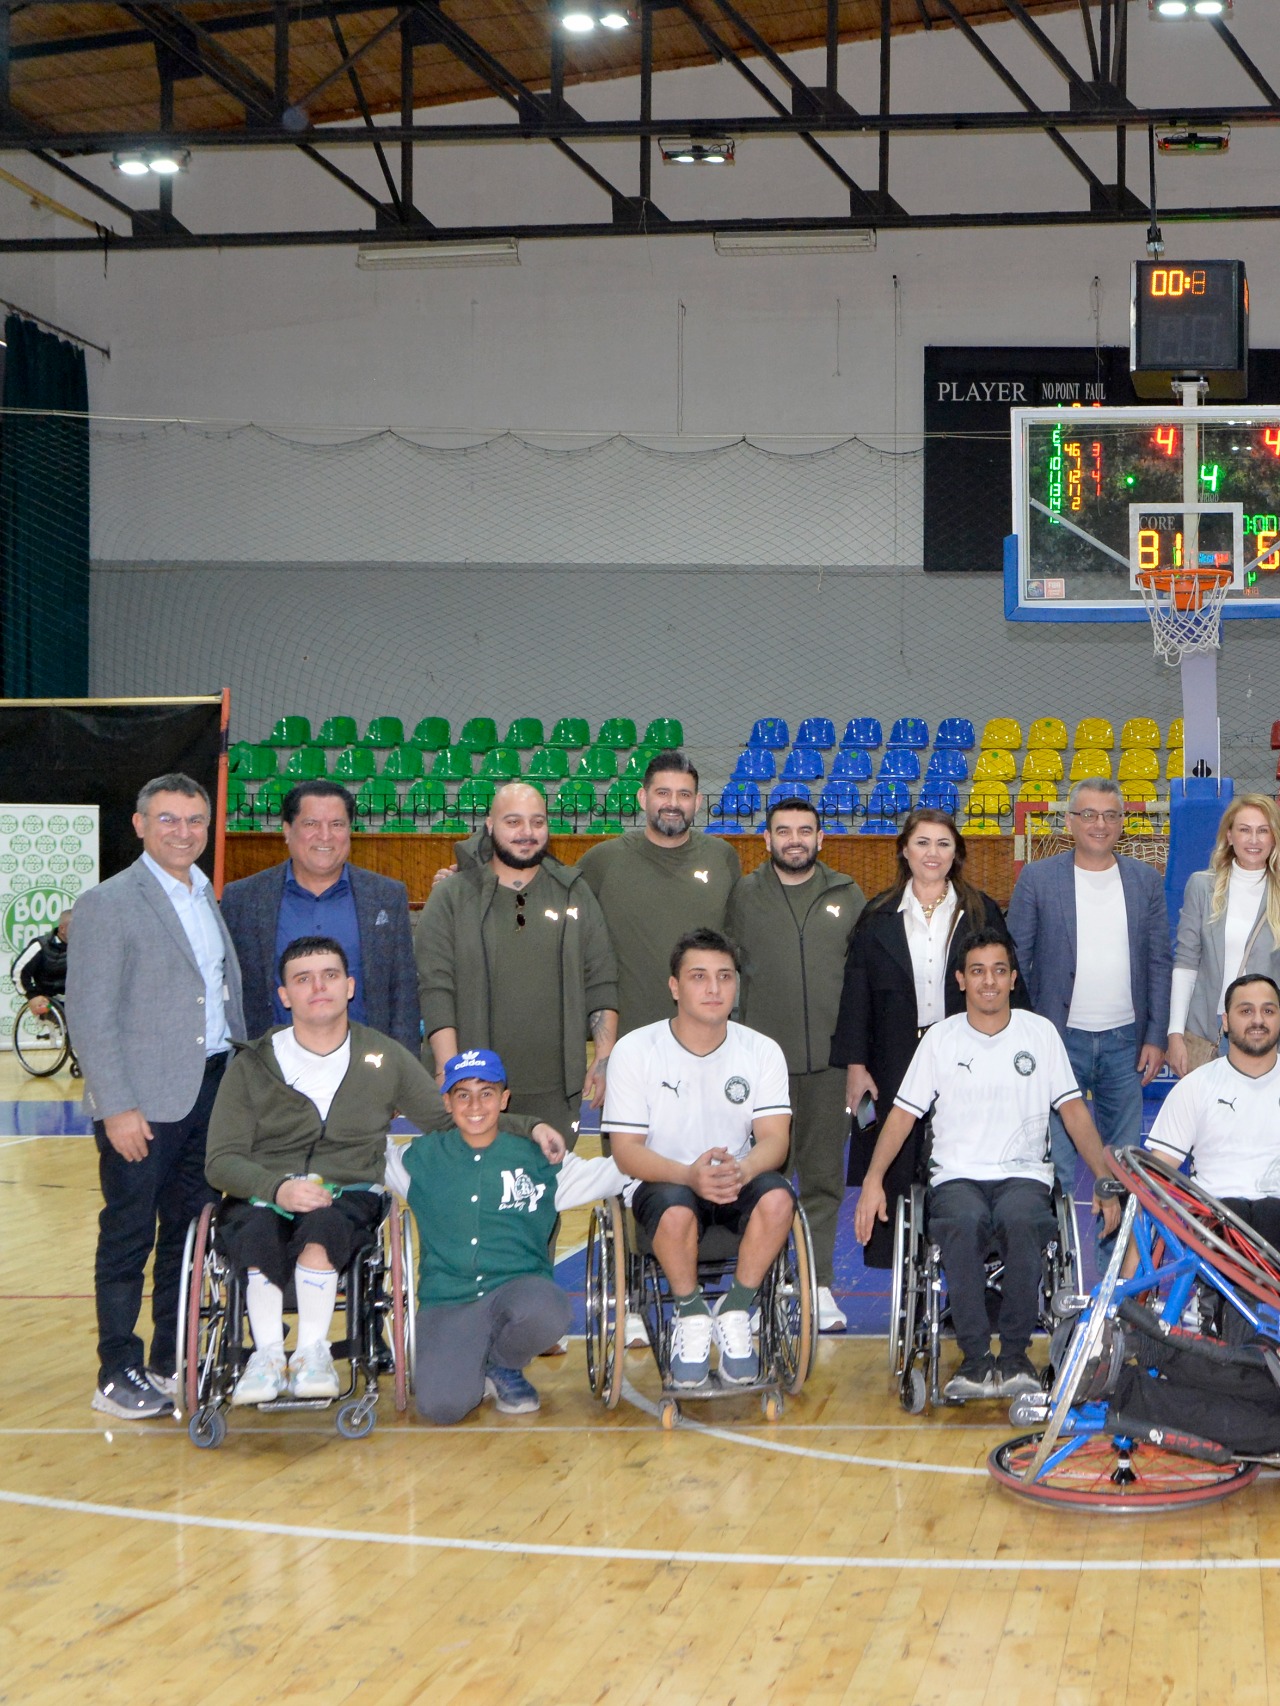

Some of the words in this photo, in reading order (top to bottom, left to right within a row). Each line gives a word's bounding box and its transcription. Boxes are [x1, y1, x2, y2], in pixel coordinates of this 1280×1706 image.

[938, 382, 1027, 401] PLAYER
[1042, 383, 1054, 400] NO
[1055, 383, 1080, 400] POINT
[1085, 383, 1106, 400] FAUL
[1155, 427, 1176, 456] 4
[1053, 443, 1061, 457] 7
[1064, 443, 1080, 457] 46
[1091, 443, 1101, 457] 3
[1049, 457, 1061, 470] 10
[1068, 470, 1081, 484] 12
[1091, 470, 1101, 484] 4
[1199, 464, 1219, 493] 4
[1049, 483, 1061, 497] 13
[1068, 484, 1081, 497] 11
[1049, 497, 1061, 510] 14
[1071, 497, 1081, 511] 2
[1138, 530, 1182, 569] 81
[454, 1058, 487, 1070] adidas
